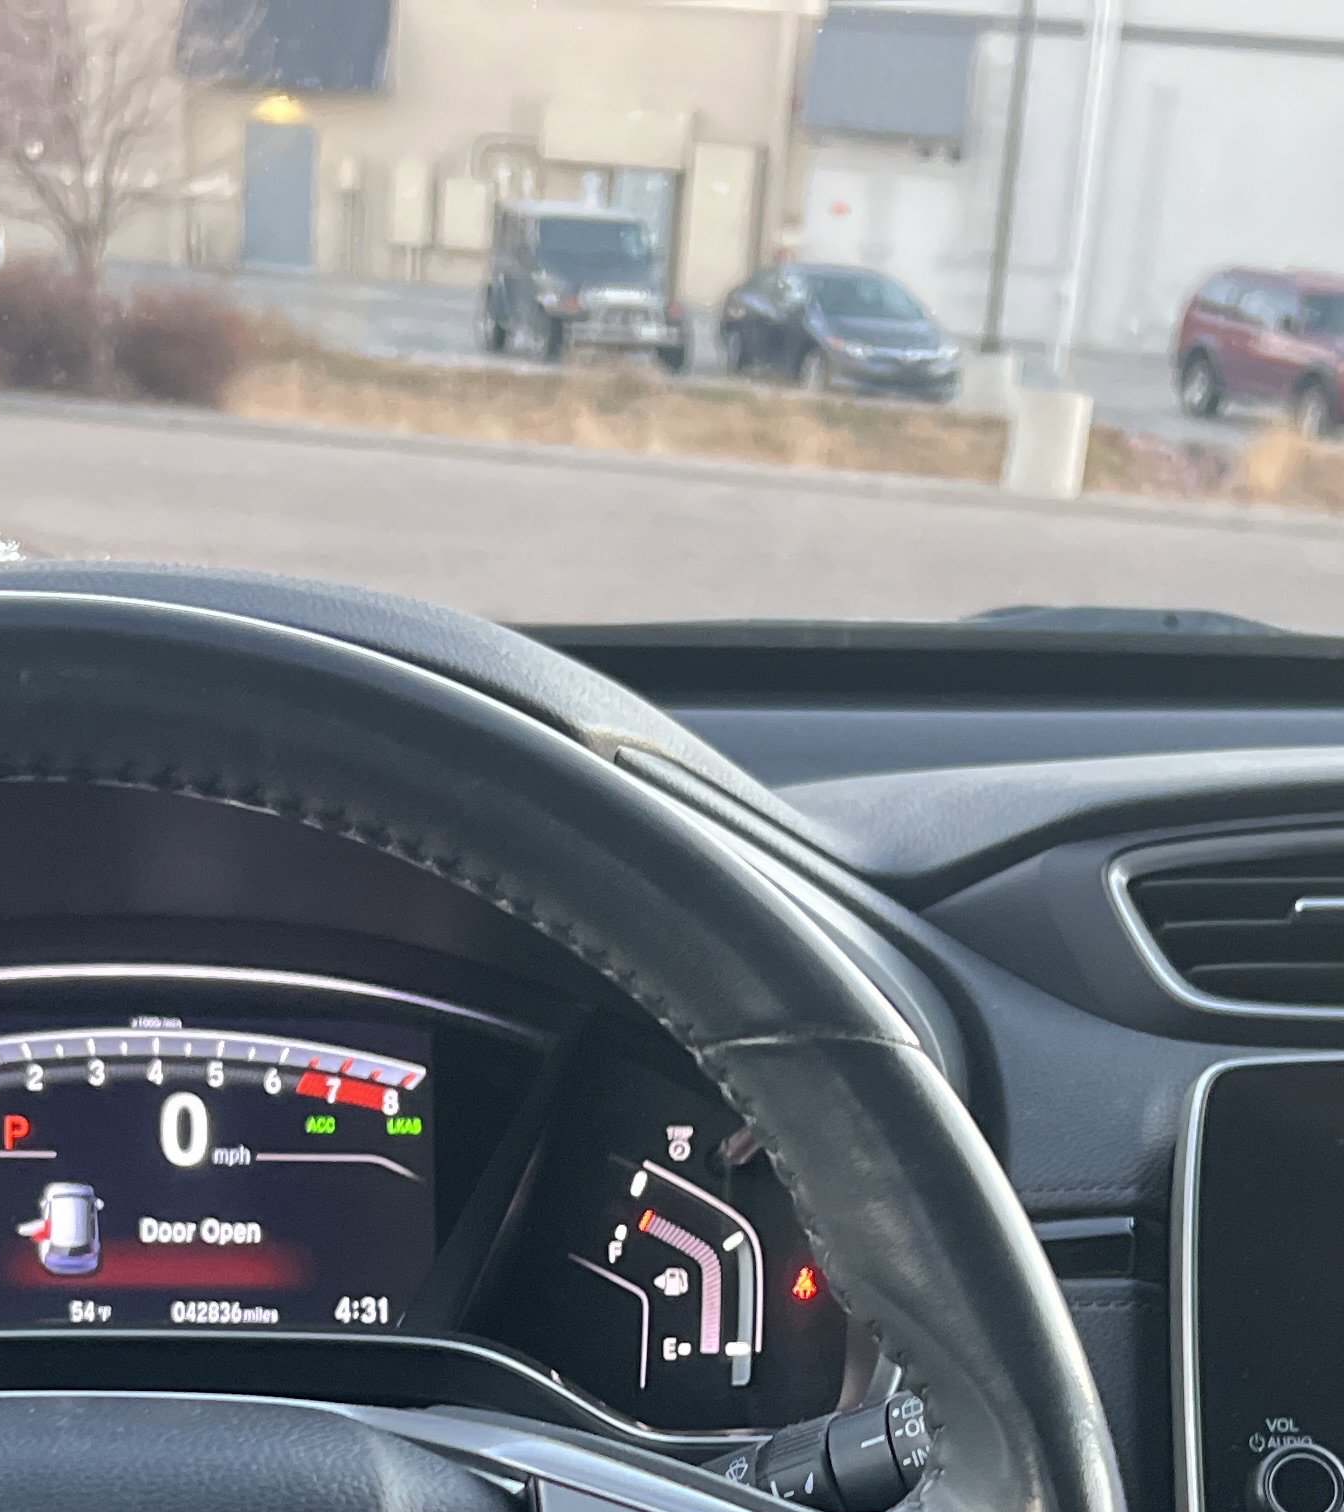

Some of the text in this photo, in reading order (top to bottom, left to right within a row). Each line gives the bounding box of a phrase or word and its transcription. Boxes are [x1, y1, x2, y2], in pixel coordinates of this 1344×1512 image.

[25, 1064, 44, 1091] 2
[88, 1059, 105, 1086] 3
[146, 1059, 163, 1085] 4
[208, 1061, 224, 1087] 5
[264, 1068, 281, 1094] 6
[326, 1079, 341, 1103] 7
[382, 1089, 399, 1115] 8
[3, 1114, 31, 1150] P
[159, 1091, 251, 1167] 0 mph
[139, 1217, 262, 1245] Door Open
[608, 1241, 622, 1263] F
[334, 1296, 389, 1324] 4:31
[662, 1337, 677, 1361] E
[1265, 1418, 1300, 1433] VOL
